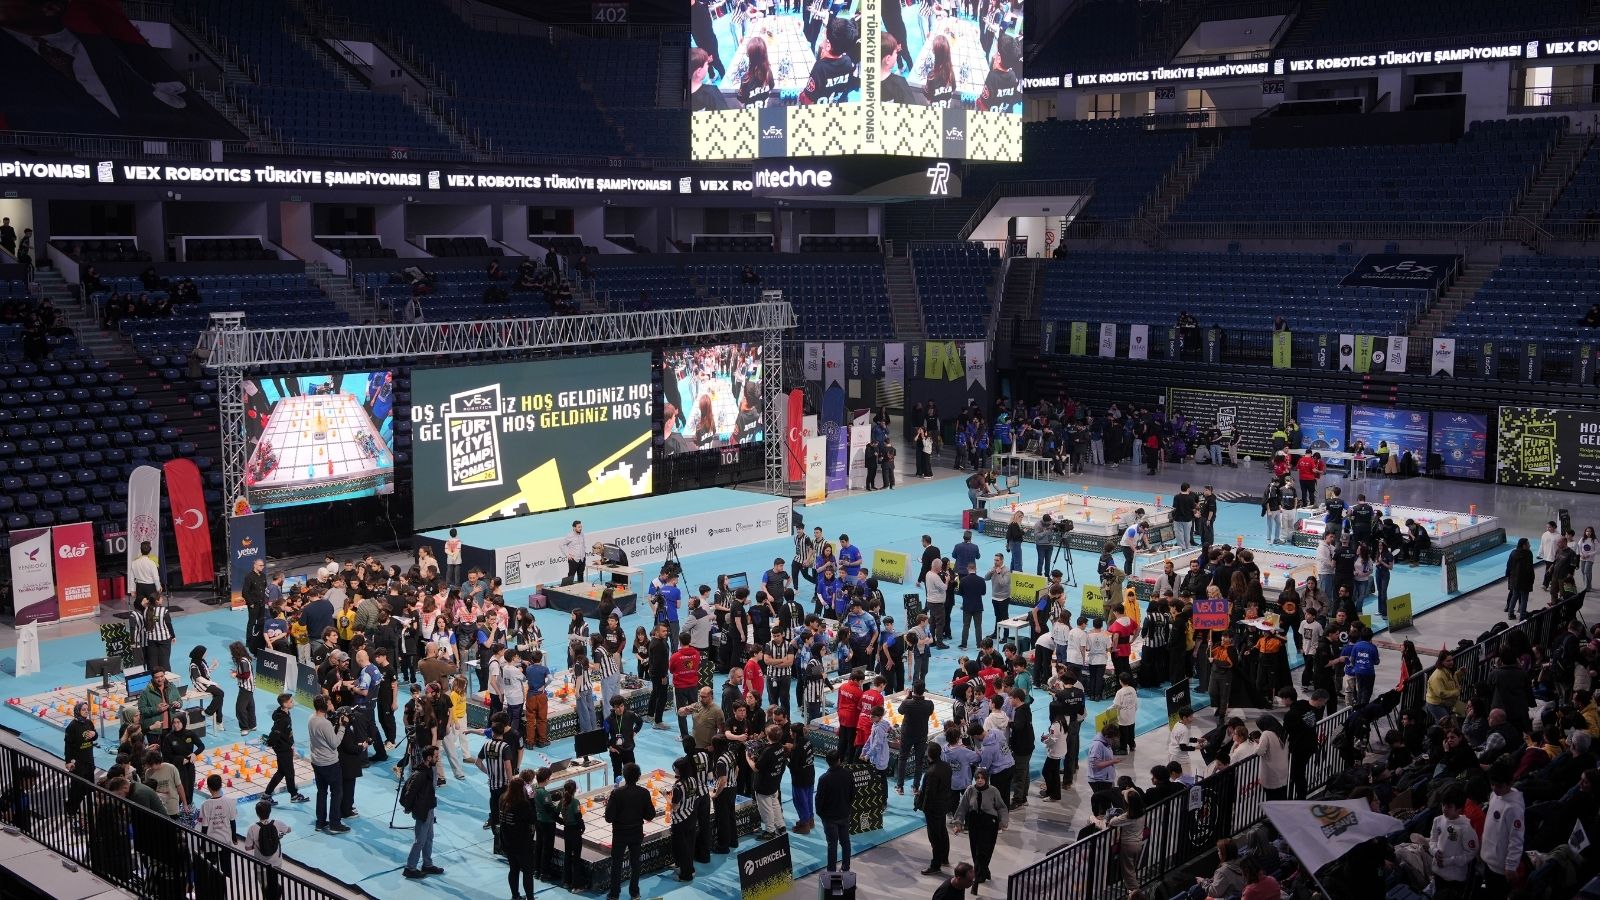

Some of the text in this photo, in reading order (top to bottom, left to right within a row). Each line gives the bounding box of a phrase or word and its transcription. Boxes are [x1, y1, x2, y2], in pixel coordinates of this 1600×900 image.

[595, 8, 627, 22] 402
[866, 14, 878, 63] TÜRKİYE
[1546, 42, 1574, 54] VEX
[1290, 45, 1521, 71] VEX ROBOTICS TÜRKİYE ŞAMPİYONASI
[1078, 63, 1268, 84] VEX ROBOTICS TÜRKİYE ŞAMPİYONASI
[1157, 88, 1174, 98] 326
[1264, 83, 1284, 94] 325
[865, 66, 876, 143] ŞAMPİYONASI
[763, 126, 782, 134] VEX
[946, 127, 963, 137] VEX
[391, 151, 408, 160] 304
[0, 161, 90, 179] PİYONASI
[124, 166, 421, 187] VEX ROBOTICS TÜRKİYE ŞAMPİYONASI
[448, 174, 672, 192] VEX ROBOTICS TÜRKİYE ŞAMPİYONASI
[700, 180, 730, 191] VEX
[1372, 261, 1438, 272] VEX
[463, 394, 492, 406] VEX
[521, 394, 553, 412] HOŞ
[558, 386, 624, 408] GELDİNİZ
[503, 414, 535, 432] HOŞ
[540, 406, 608, 429] GELDİNİZ
[612, 403, 641, 420] HOŞ
[1580, 422, 1600, 433] HO
[452, 431, 492, 458] KİYE
[722, 452, 739, 464] 104
[664, 524, 697, 538] sahnesi
[237, 547, 259, 559] yetev
[631, 542, 682, 558] seni beklior.
[1016, 581, 1034, 589] EduCat
[263, 659, 279, 670] EduCat
[754, 849, 786, 869] TURKCELL
